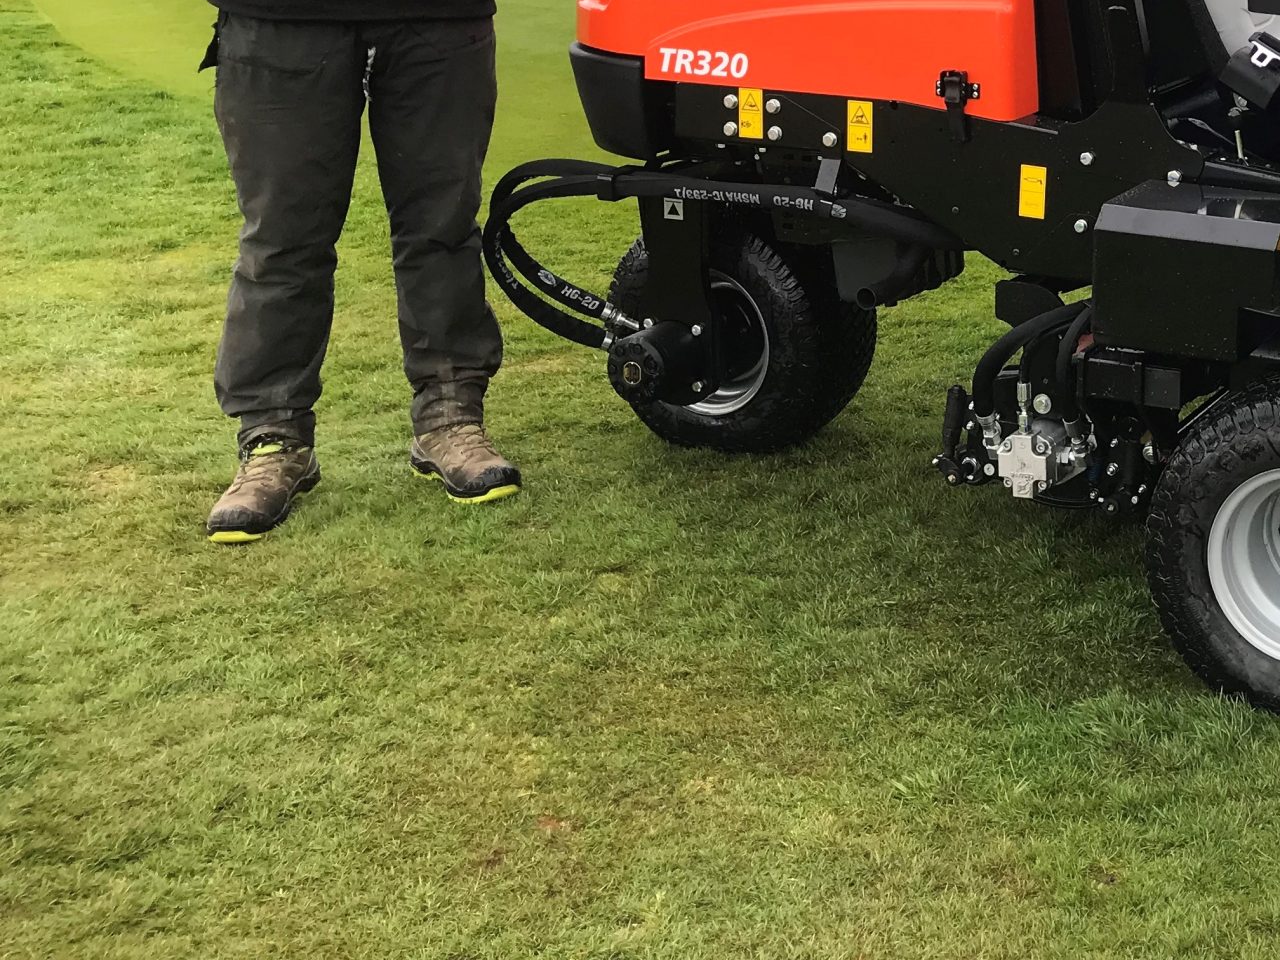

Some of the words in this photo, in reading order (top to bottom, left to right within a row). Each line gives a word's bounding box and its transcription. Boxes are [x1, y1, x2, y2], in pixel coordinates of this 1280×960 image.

[659, 48, 748, 78] TR320
[773, 195, 813, 211] HG-20
[561, 286, 600, 310] HG-20
